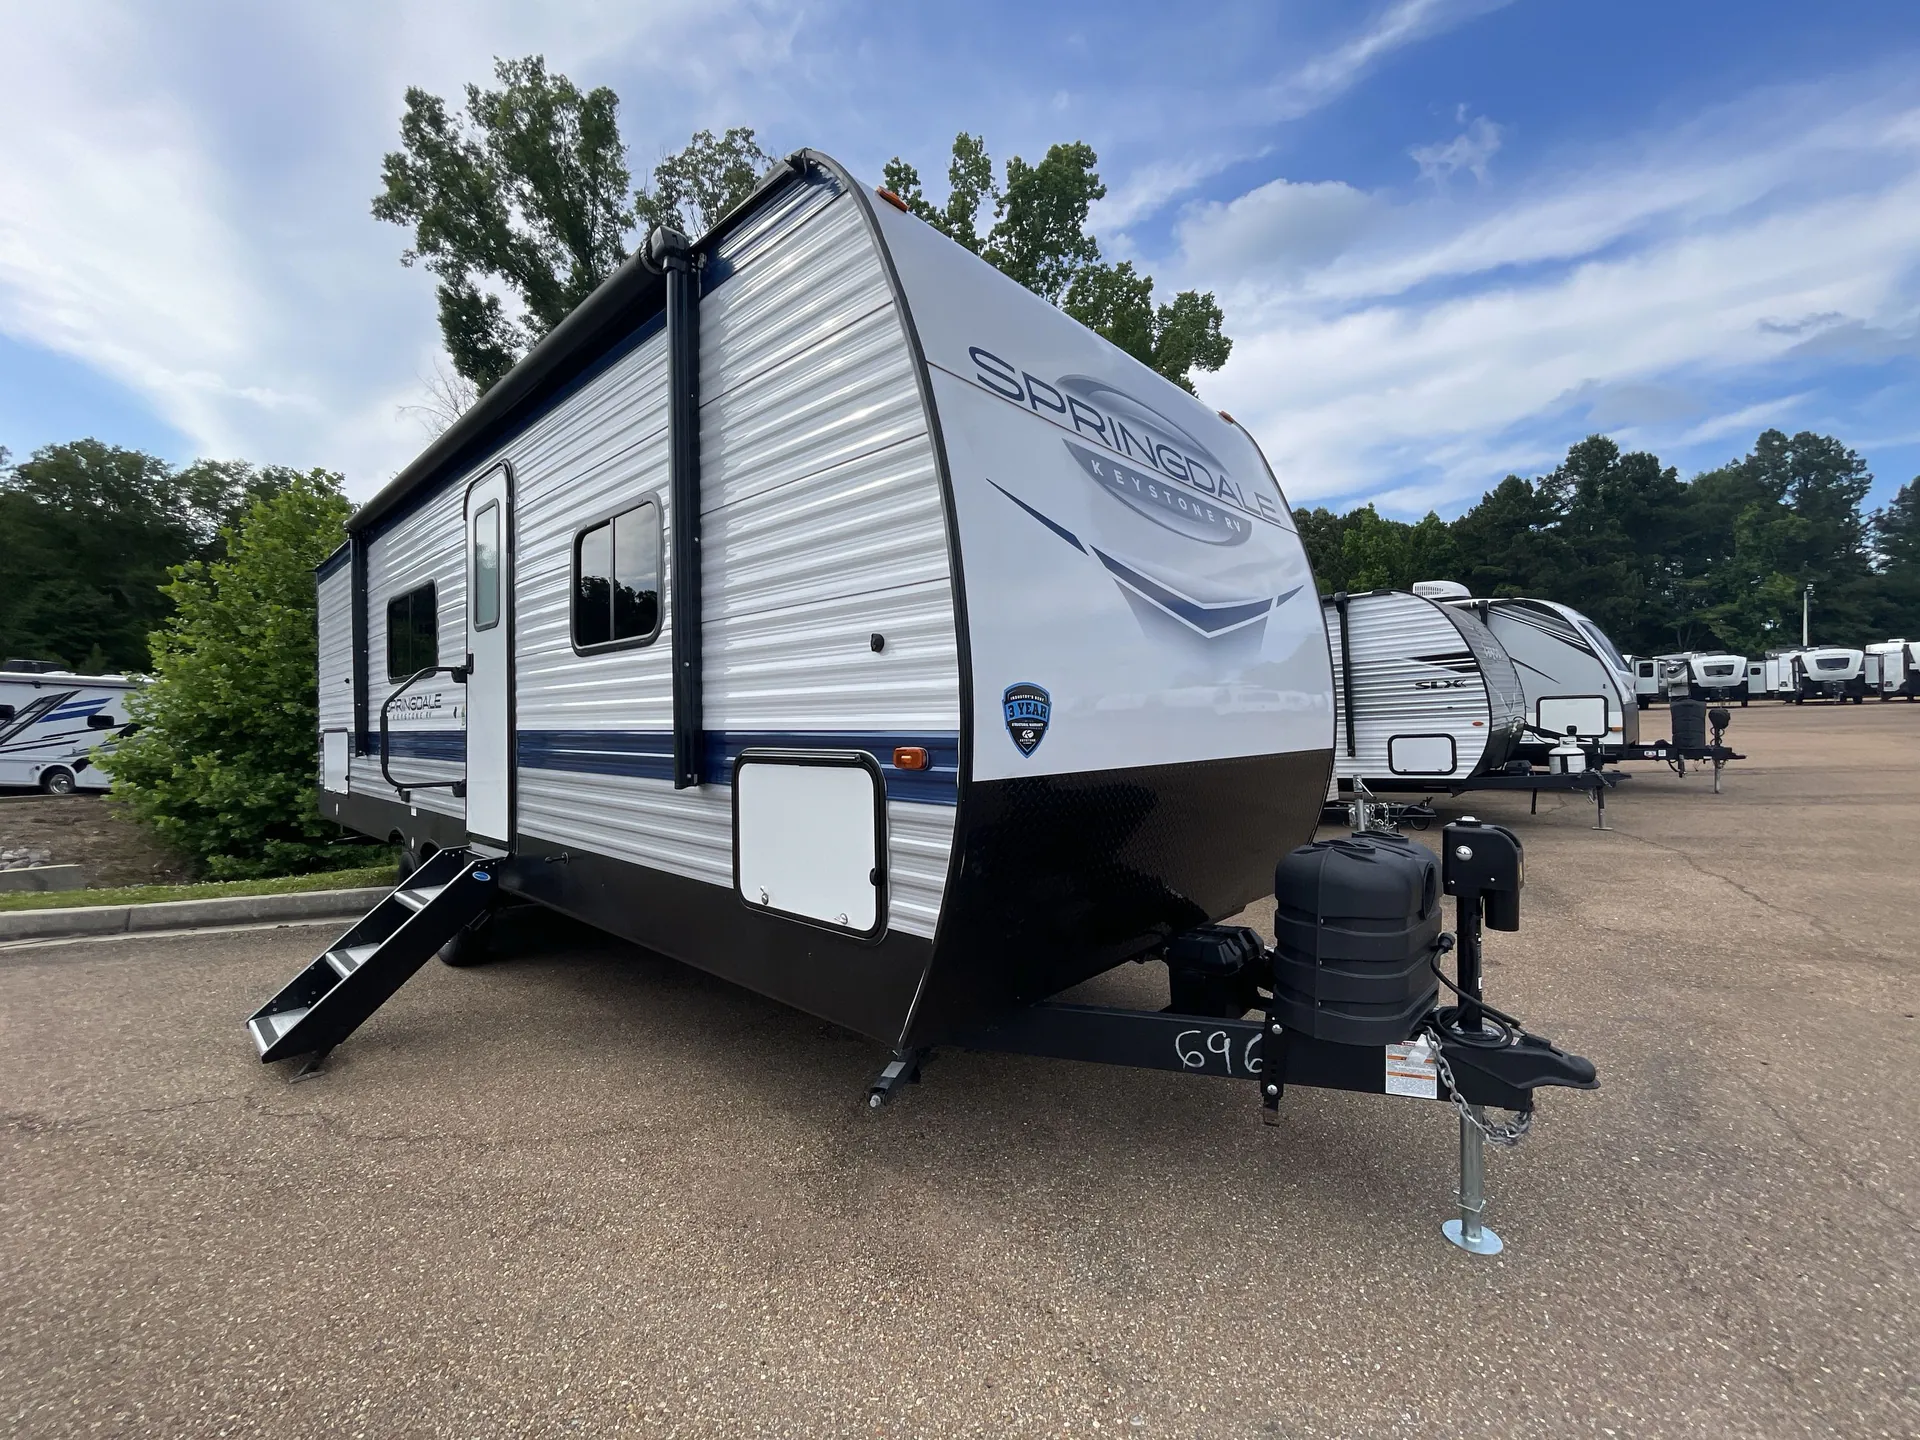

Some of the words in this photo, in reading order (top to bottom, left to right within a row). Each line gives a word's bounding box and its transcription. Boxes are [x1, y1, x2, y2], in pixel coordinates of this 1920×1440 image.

[968, 345, 1281, 524] SPRINGDALE
[1090, 459, 1215, 523] KEYSTONE
[1224, 516, 1242, 533] RV
[1415, 680, 1465, 690] SLX
[1008, 704, 1015, 718] 3
[1018, 703, 1046, 718] YEAR
[1174, 1030, 1263, 1075] 696
